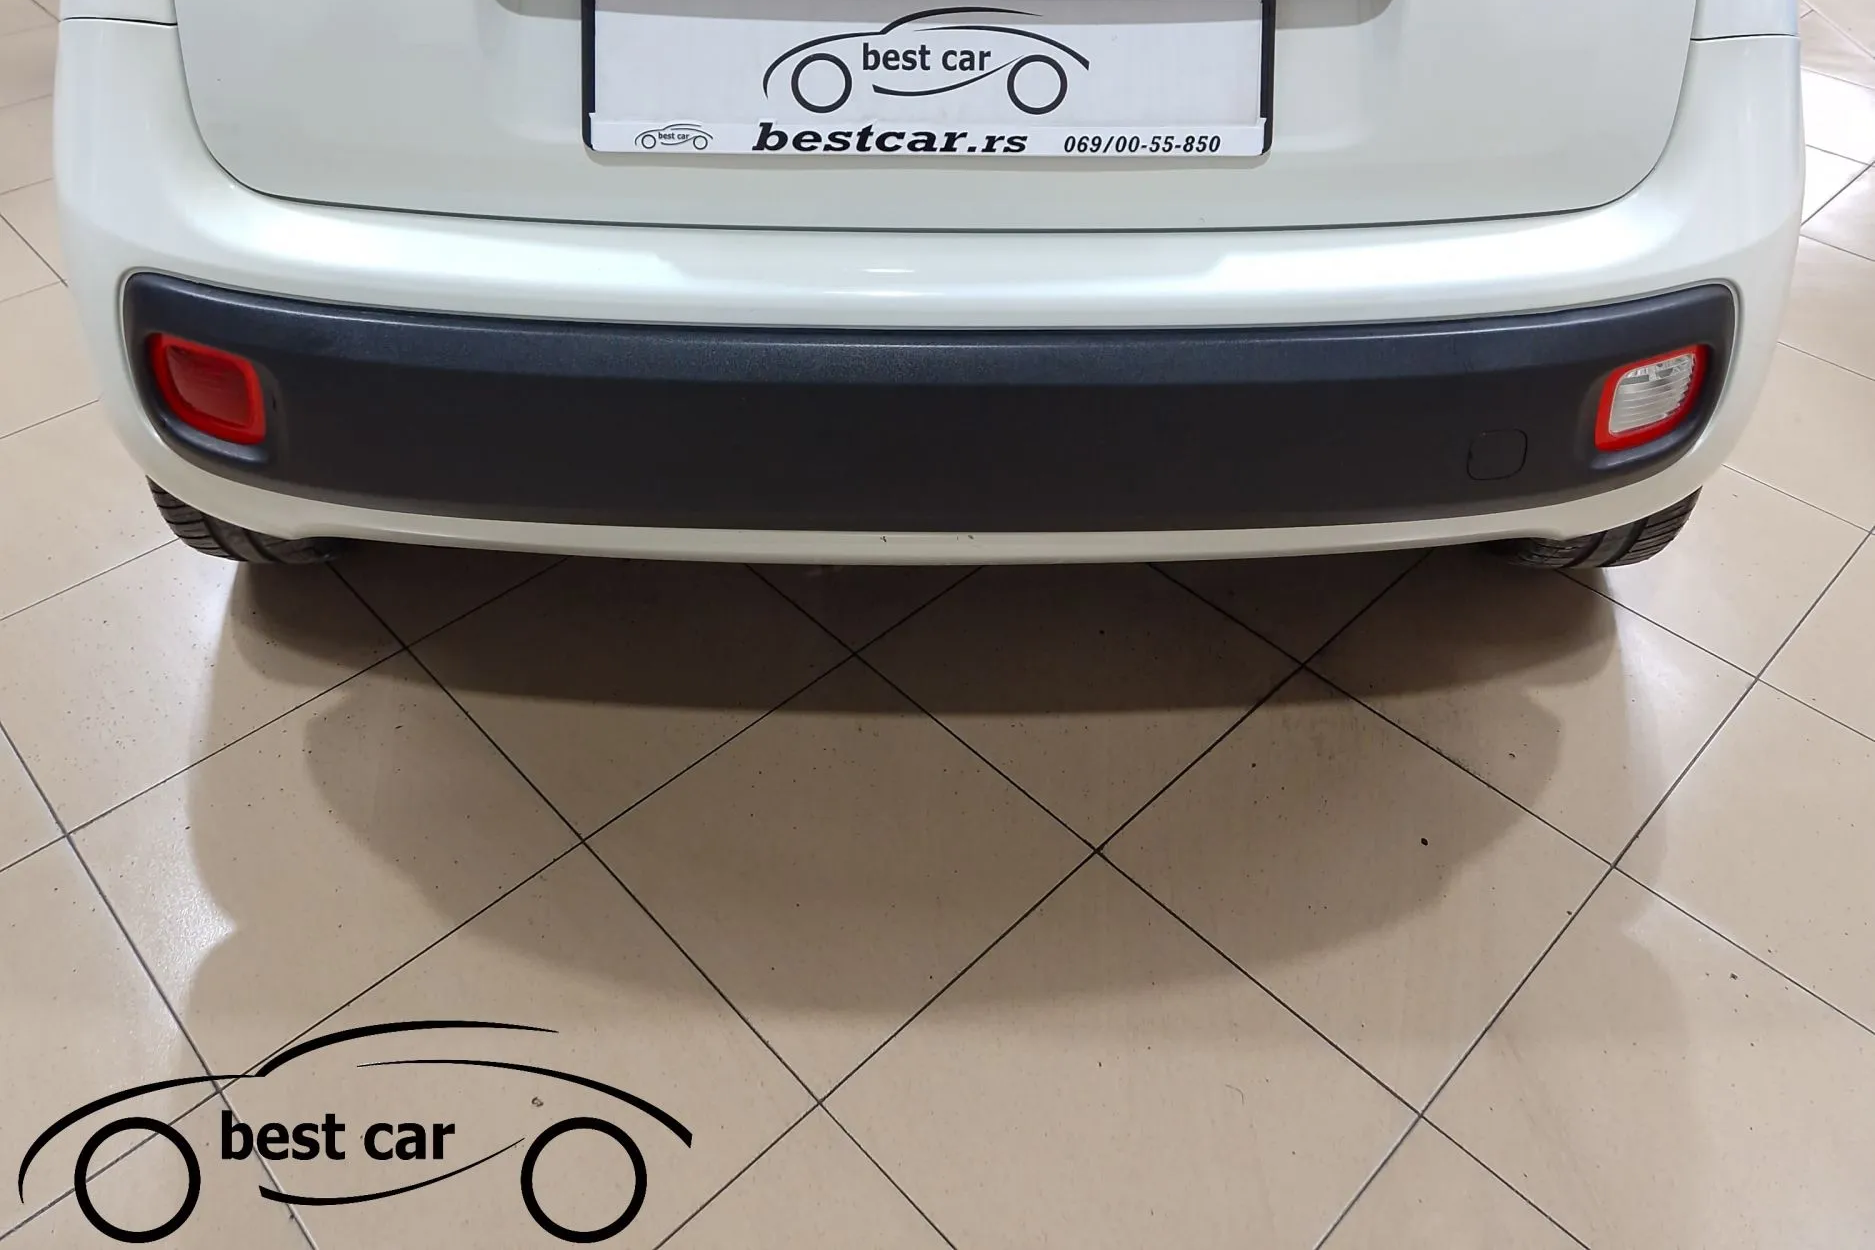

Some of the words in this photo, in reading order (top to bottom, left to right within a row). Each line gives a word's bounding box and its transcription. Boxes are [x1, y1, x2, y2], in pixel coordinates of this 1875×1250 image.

[863, 43, 931, 71] best
[942, 49, 991, 71] car
[658, 132, 675, 140] best
[752, 122, 1028, 152] bestcar.rs
[1063, 135, 1221, 154] 069/00-55-850
